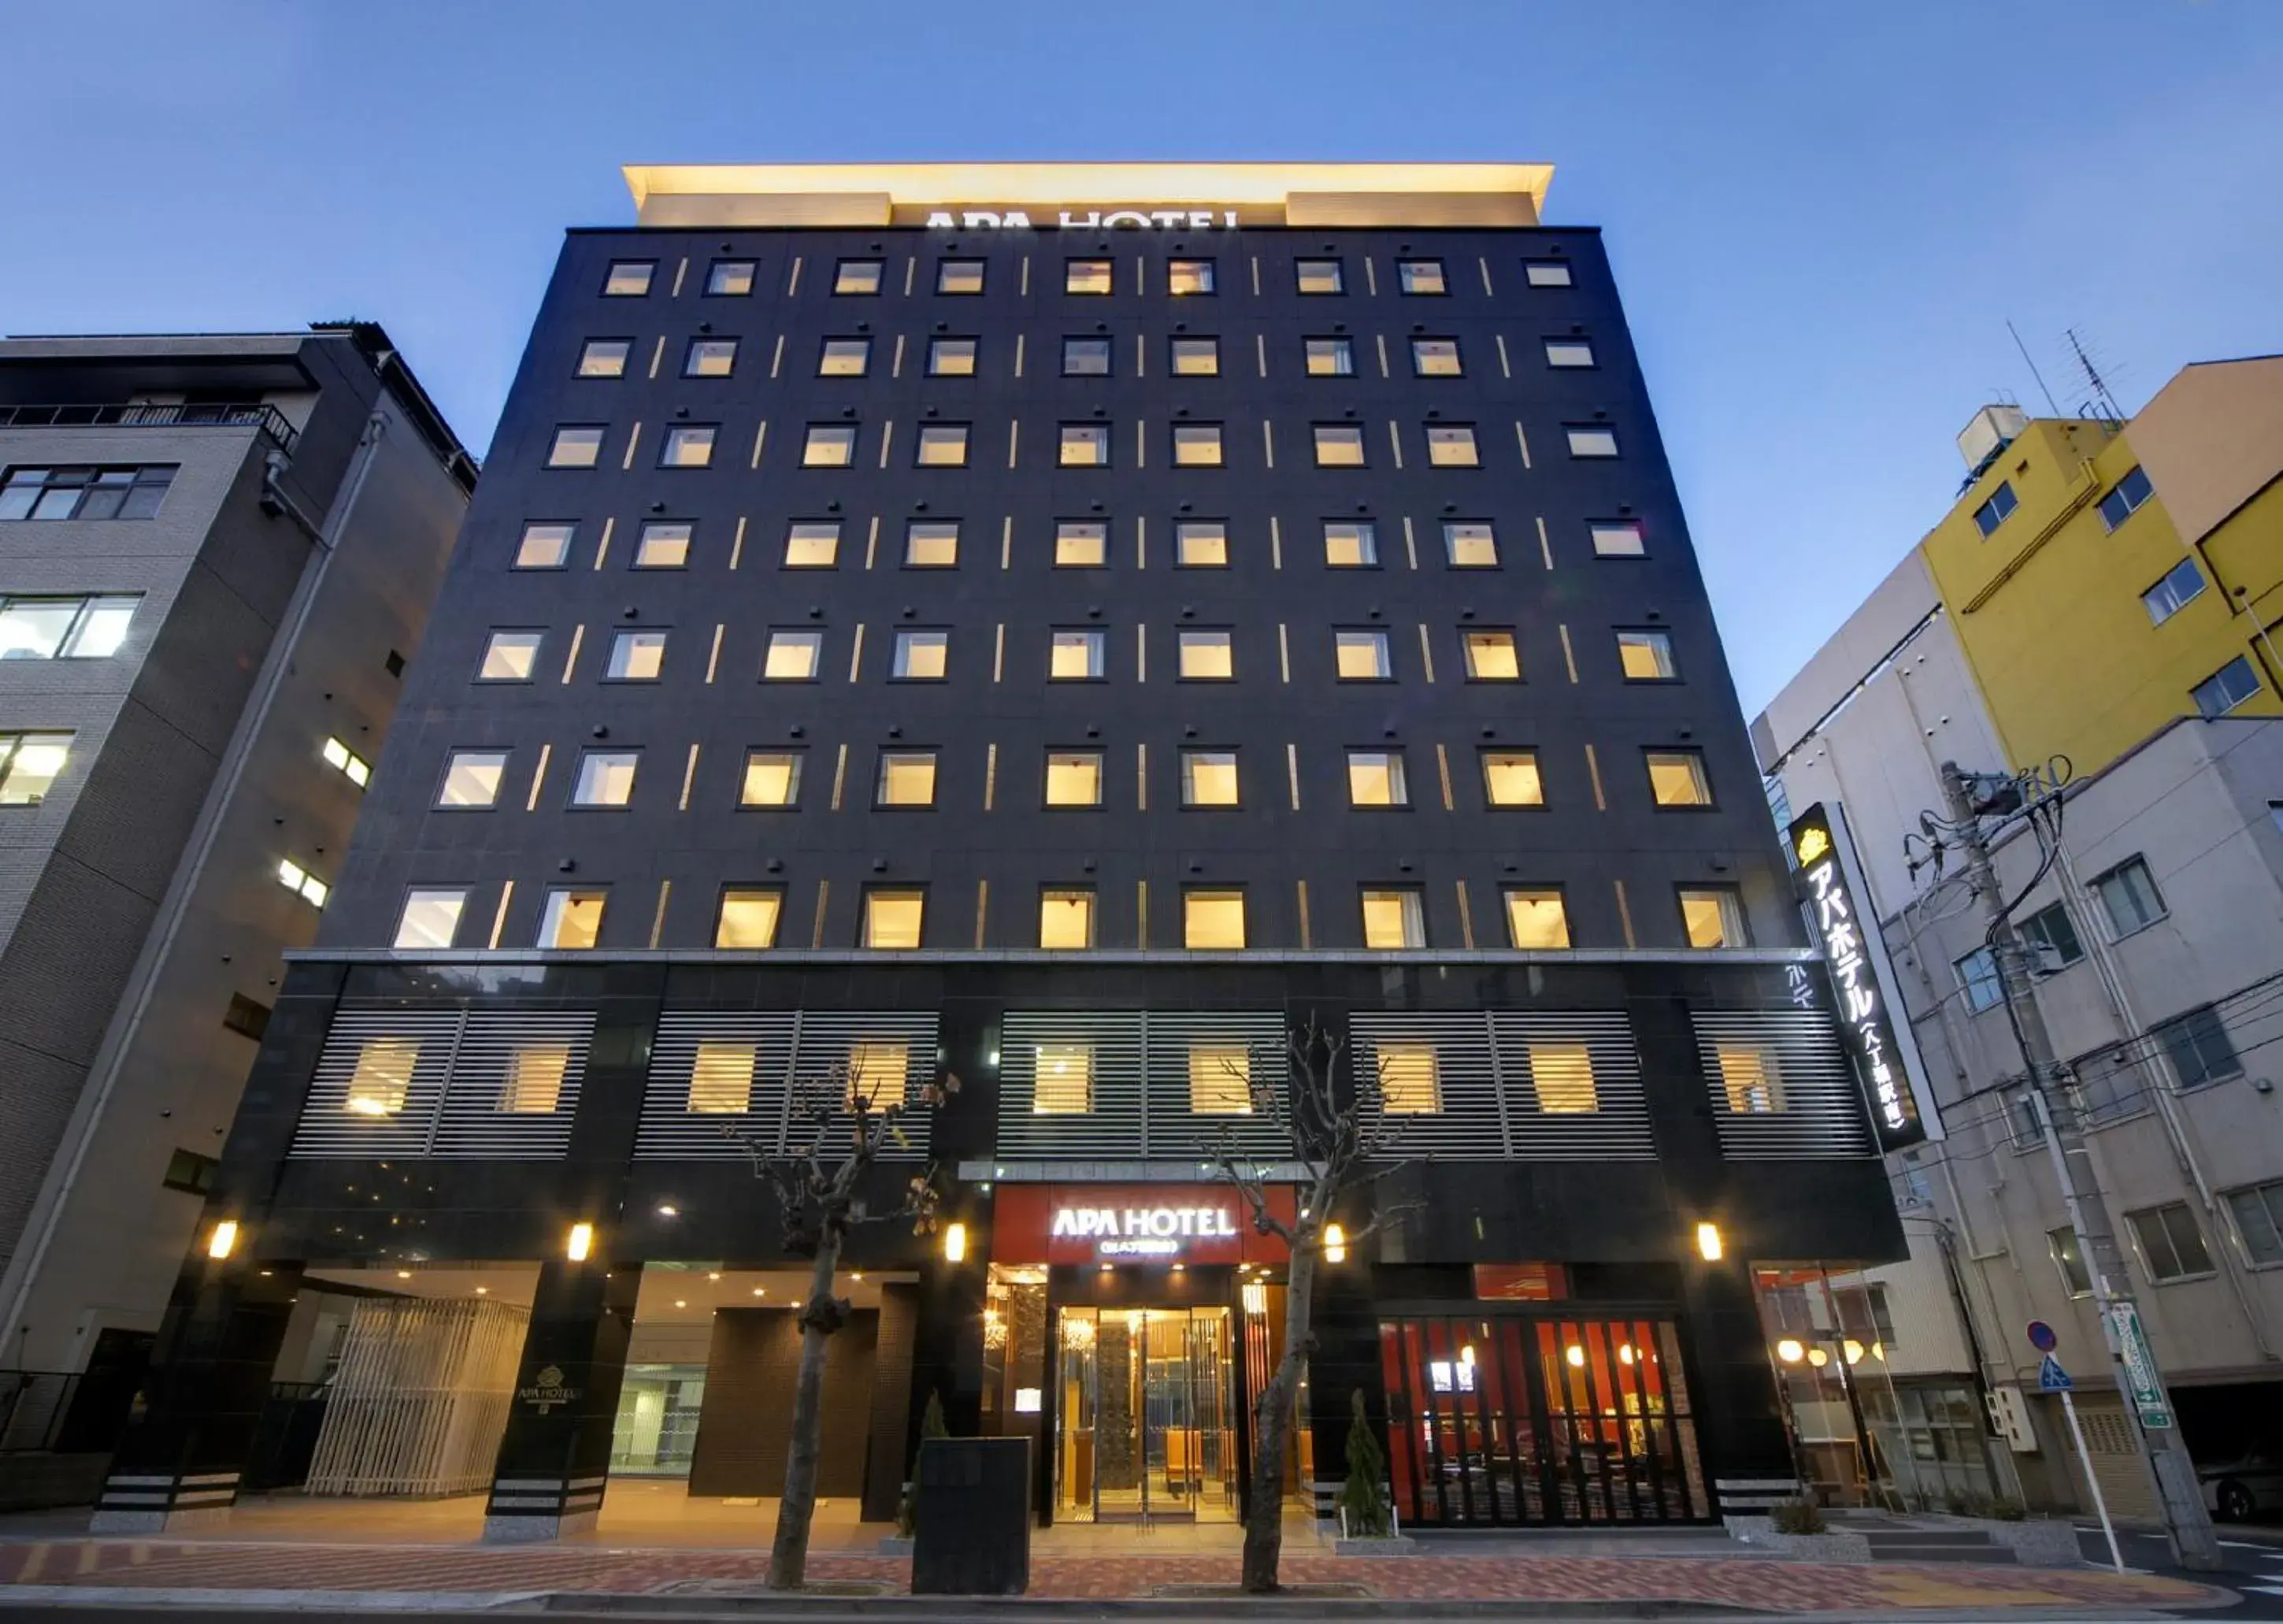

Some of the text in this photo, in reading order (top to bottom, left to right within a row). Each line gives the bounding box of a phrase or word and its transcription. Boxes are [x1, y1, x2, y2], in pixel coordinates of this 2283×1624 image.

[1809, 862, 1873, 1022] アパホテル
[1053, 1207, 1236, 1237] APA HOTEL
